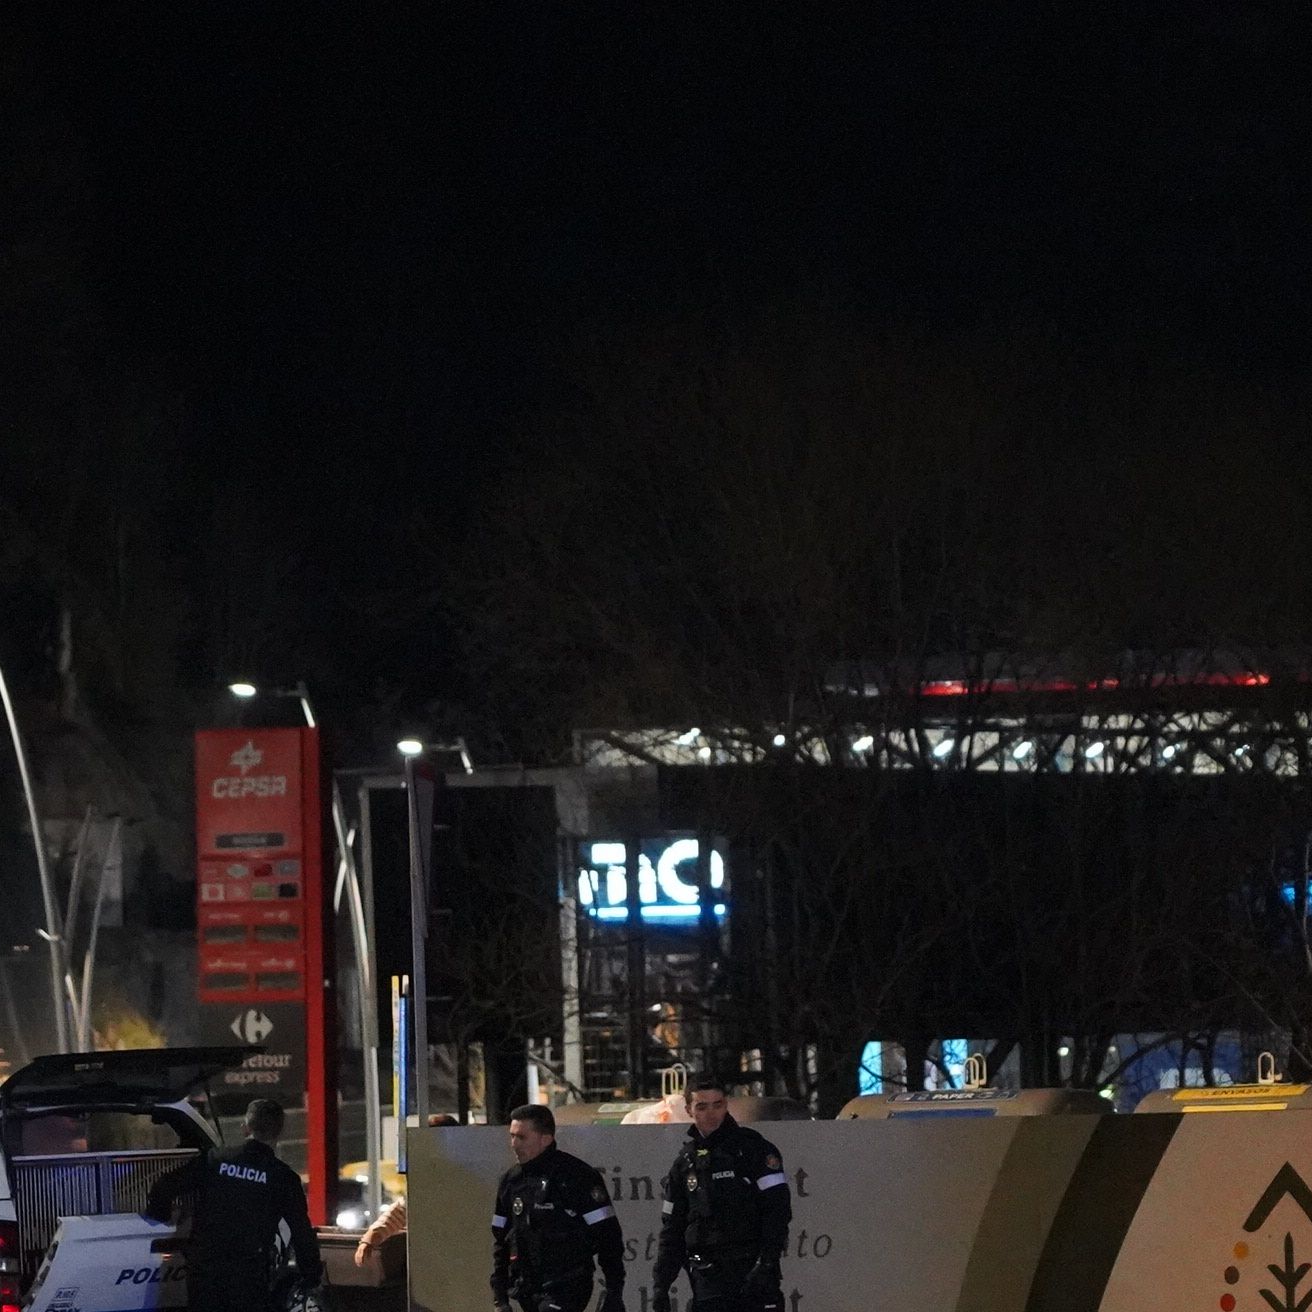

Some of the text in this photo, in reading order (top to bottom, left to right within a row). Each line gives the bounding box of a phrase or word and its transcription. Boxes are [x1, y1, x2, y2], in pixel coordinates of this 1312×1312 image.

[212, 776, 287, 799] CEPSA
[225, 1071, 280, 1086] express
[932, 1092, 975, 1100] PAPER
[219, 1162, 267, 1185] POLICIA
[115, 1265, 189, 1285] POLIC
